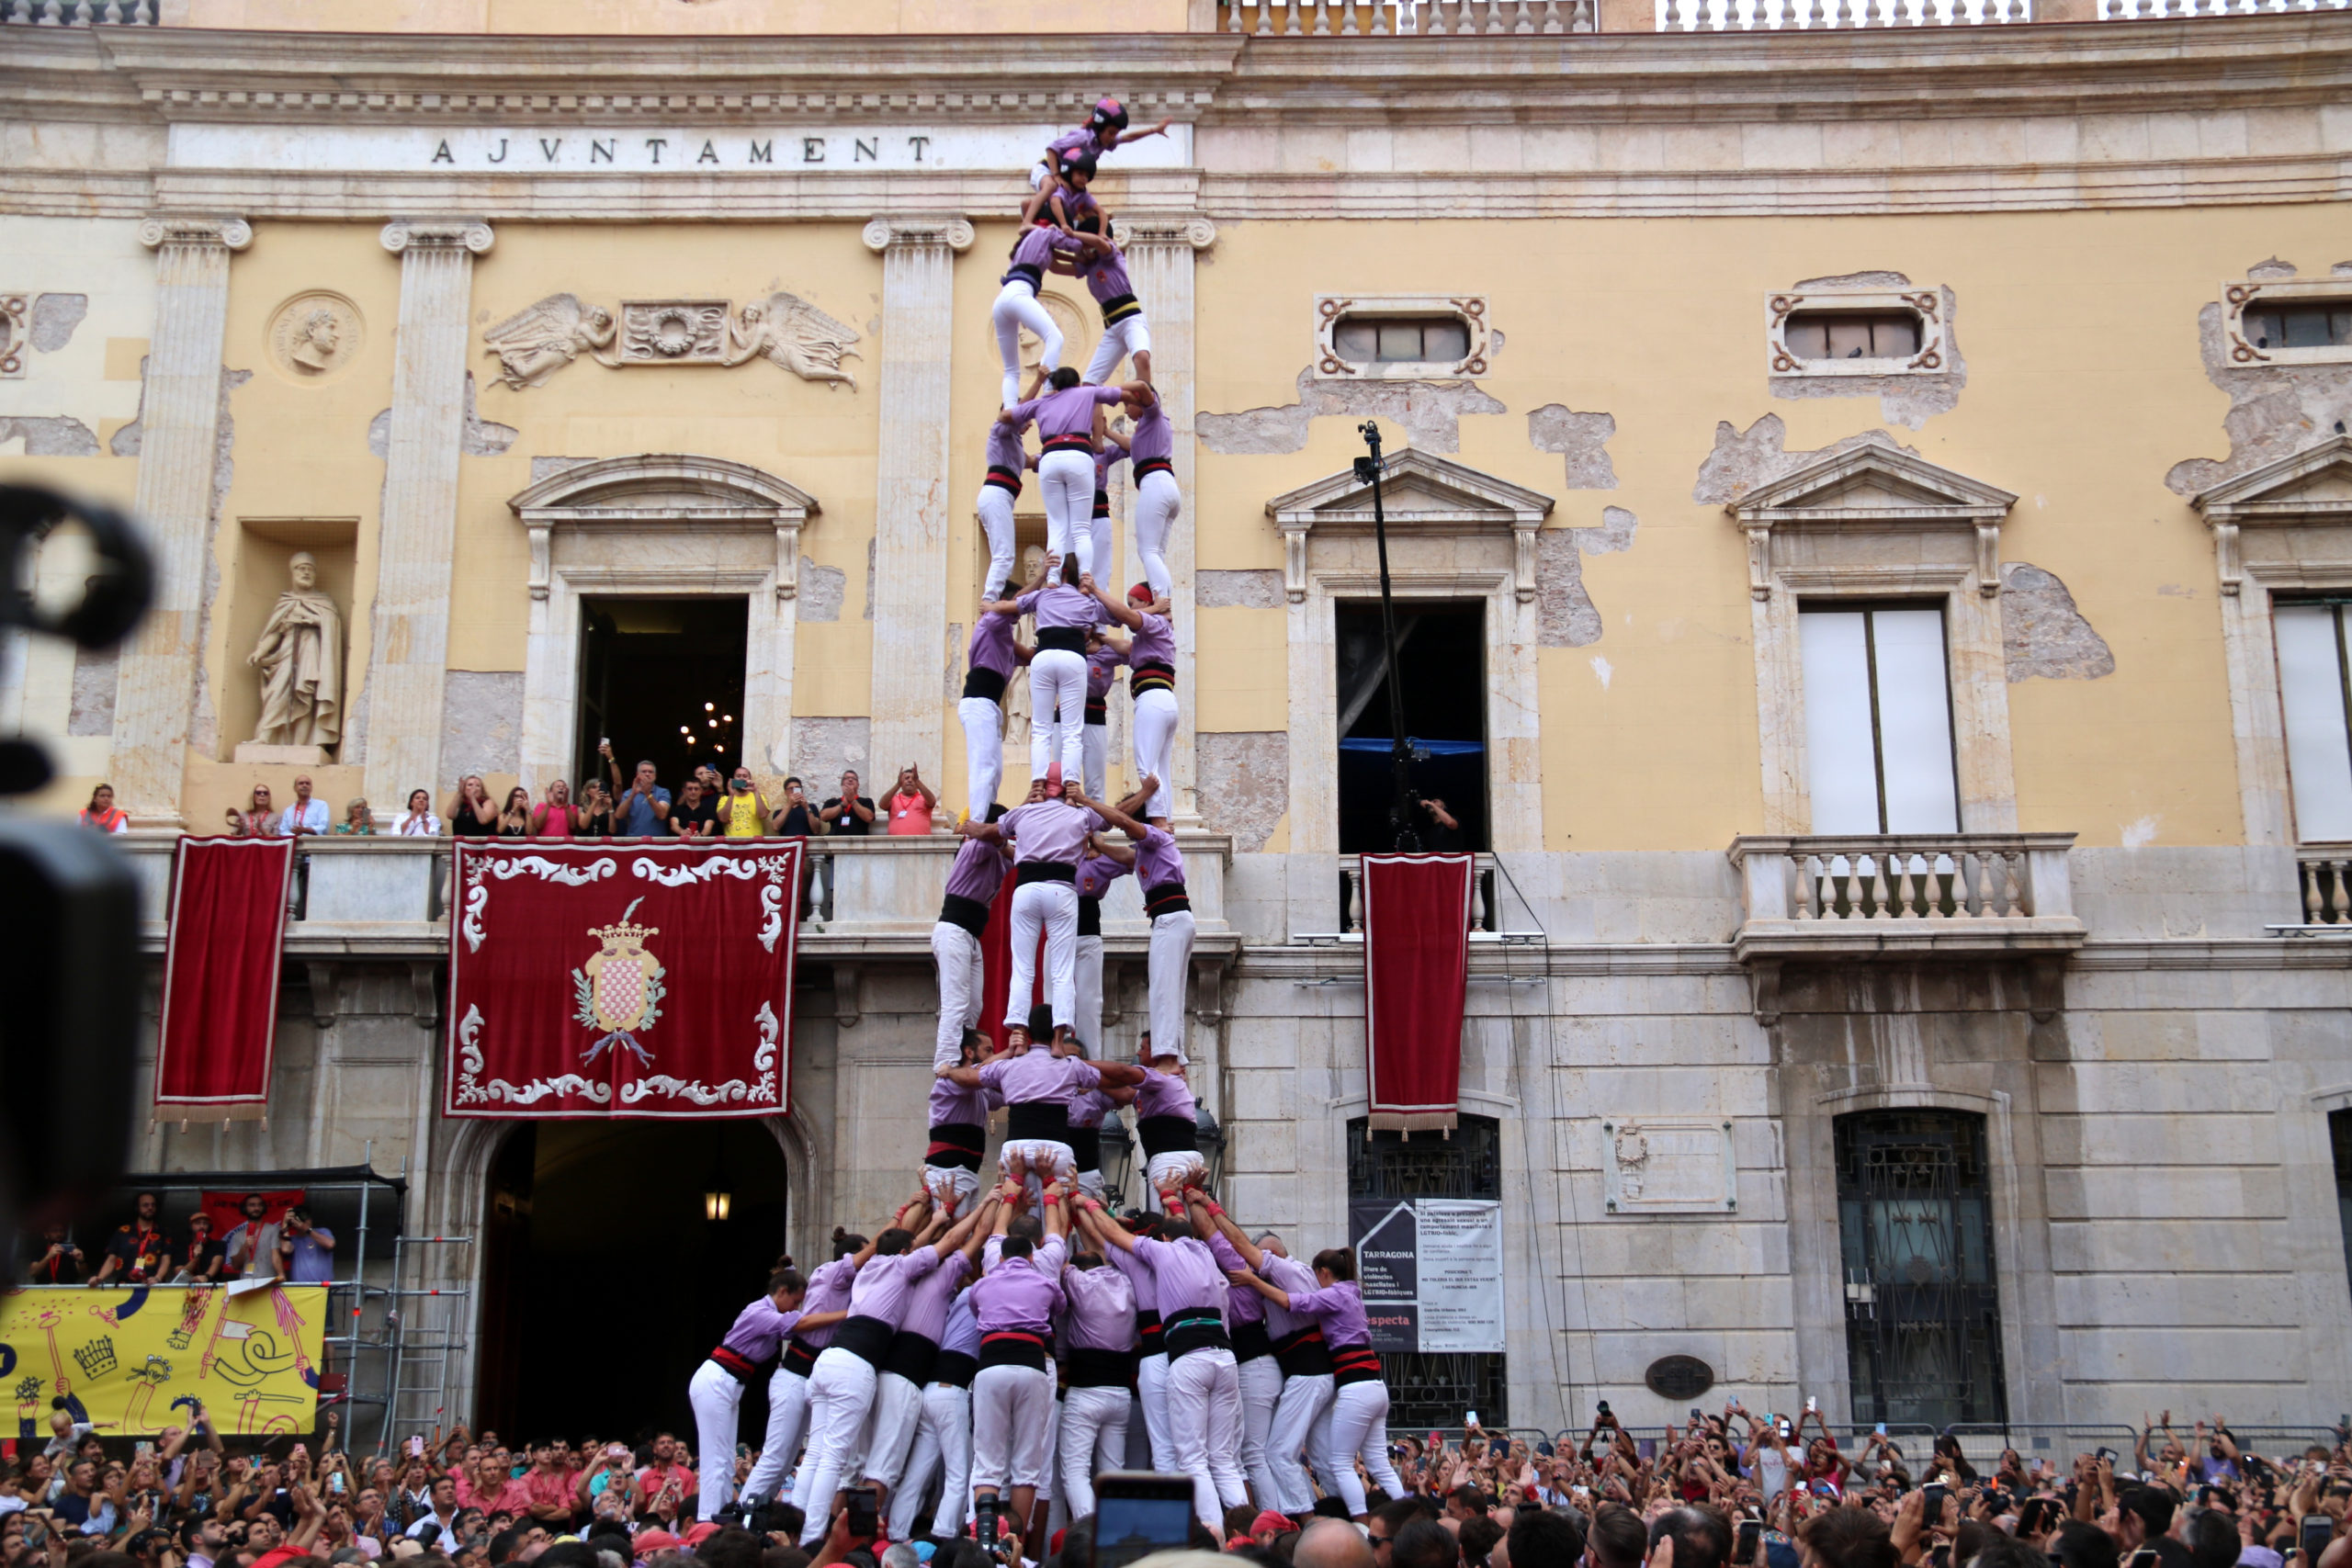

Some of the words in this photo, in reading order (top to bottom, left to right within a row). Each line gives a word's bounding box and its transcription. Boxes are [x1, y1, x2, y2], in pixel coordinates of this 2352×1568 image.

[432, 137, 930, 164] AJVNTAMENT
[1363, 1250, 1415, 1259] TARRAGONA
[1367, 1315, 1410, 1327] especta
